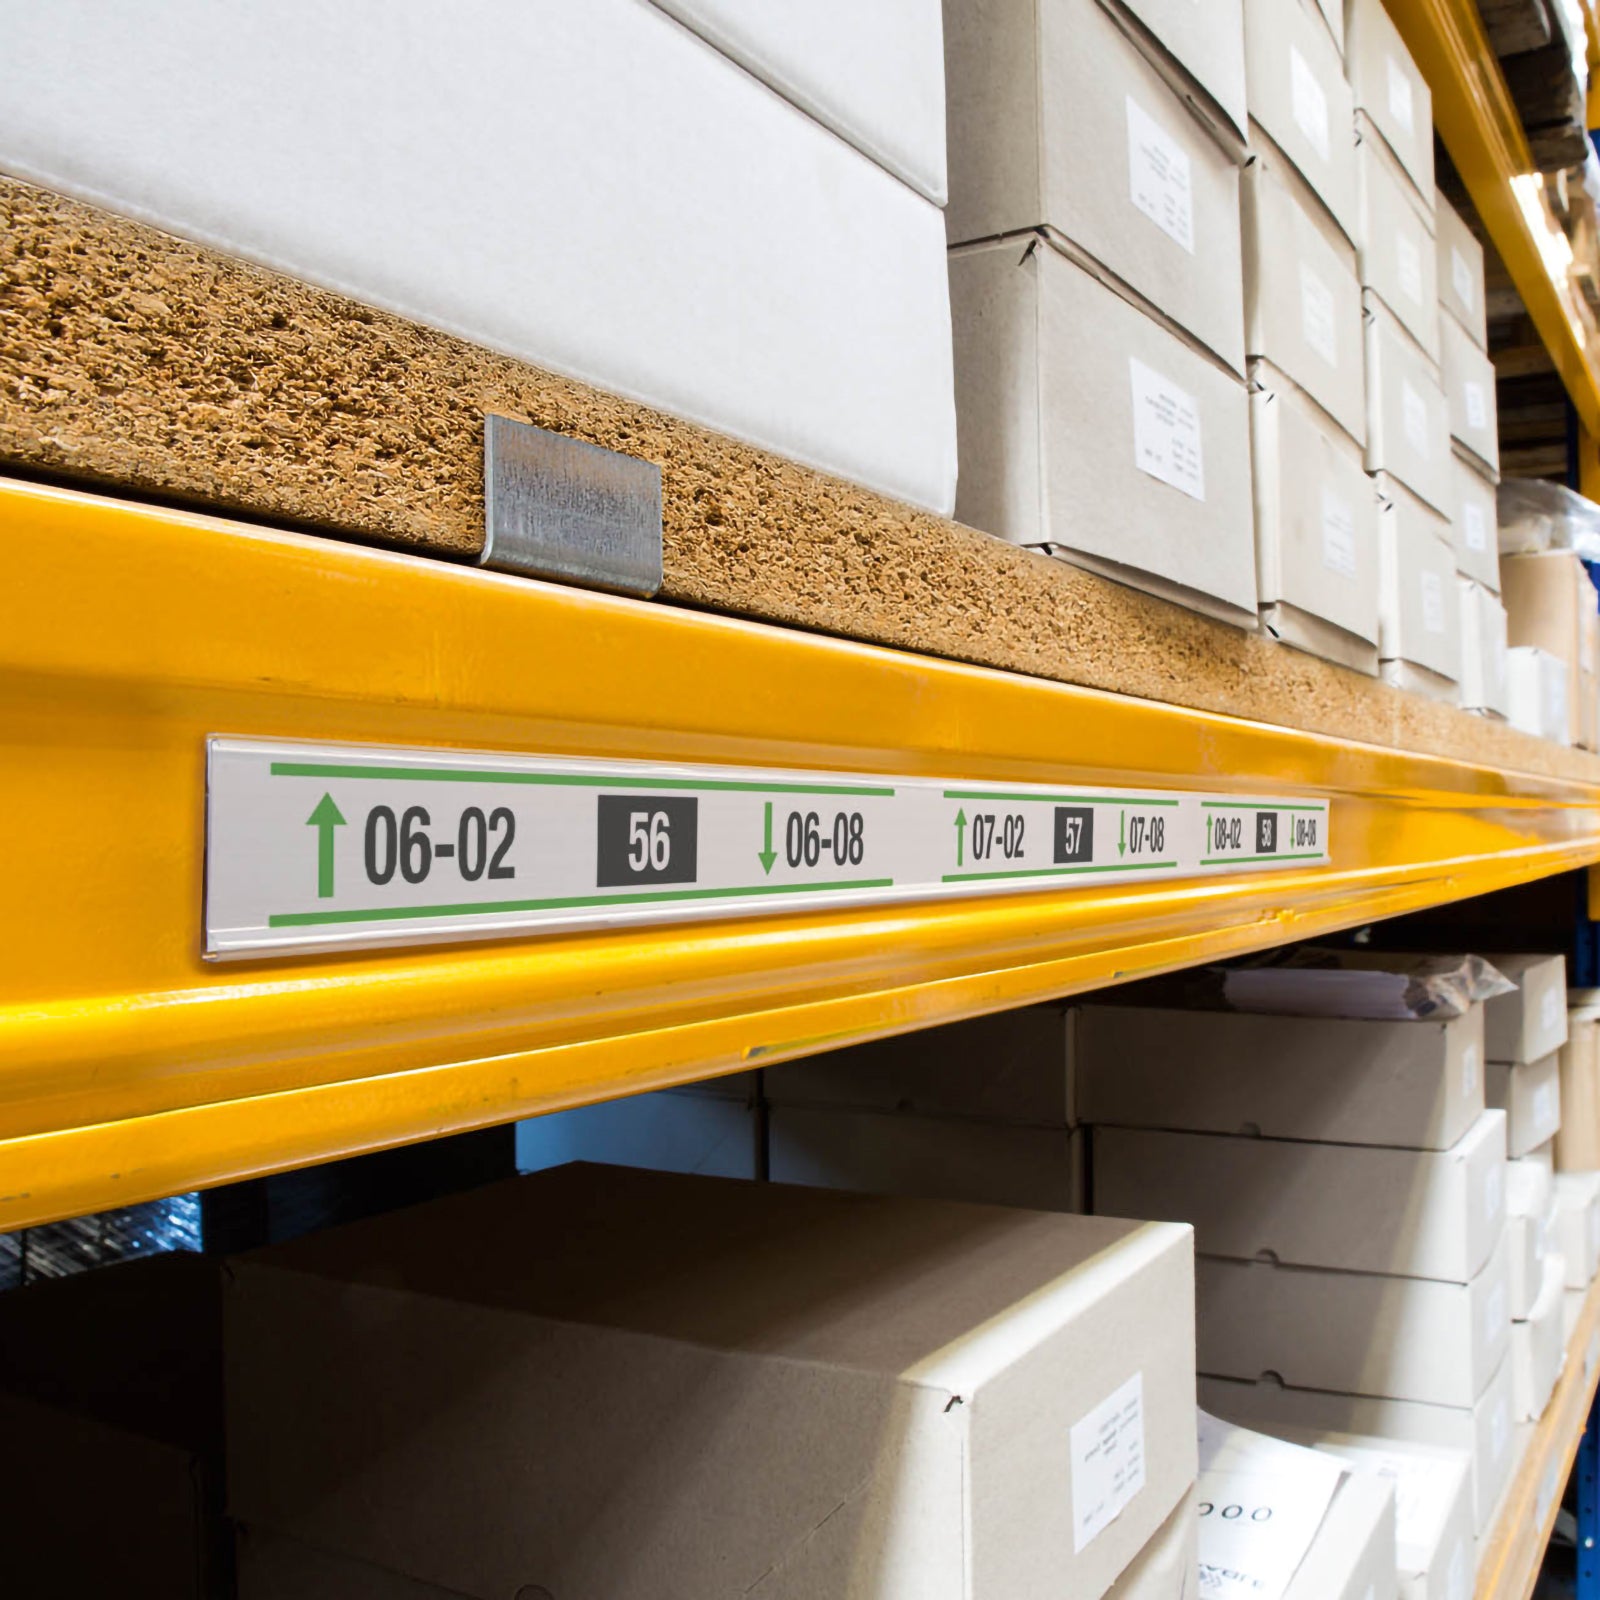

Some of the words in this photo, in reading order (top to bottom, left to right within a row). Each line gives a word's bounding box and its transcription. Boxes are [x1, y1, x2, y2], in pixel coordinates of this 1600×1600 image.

[364, 805, 516, 886] 06-02
[627, 811, 671, 872] 56
[785, 811, 864, 868] 06-08
[972, 814, 1025, 861] 07-02
[1065, 816, 1083, 855] 57
[1129, 816, 1165, 854] 07-08
[1214, 817, 1242, 851] 08-02
